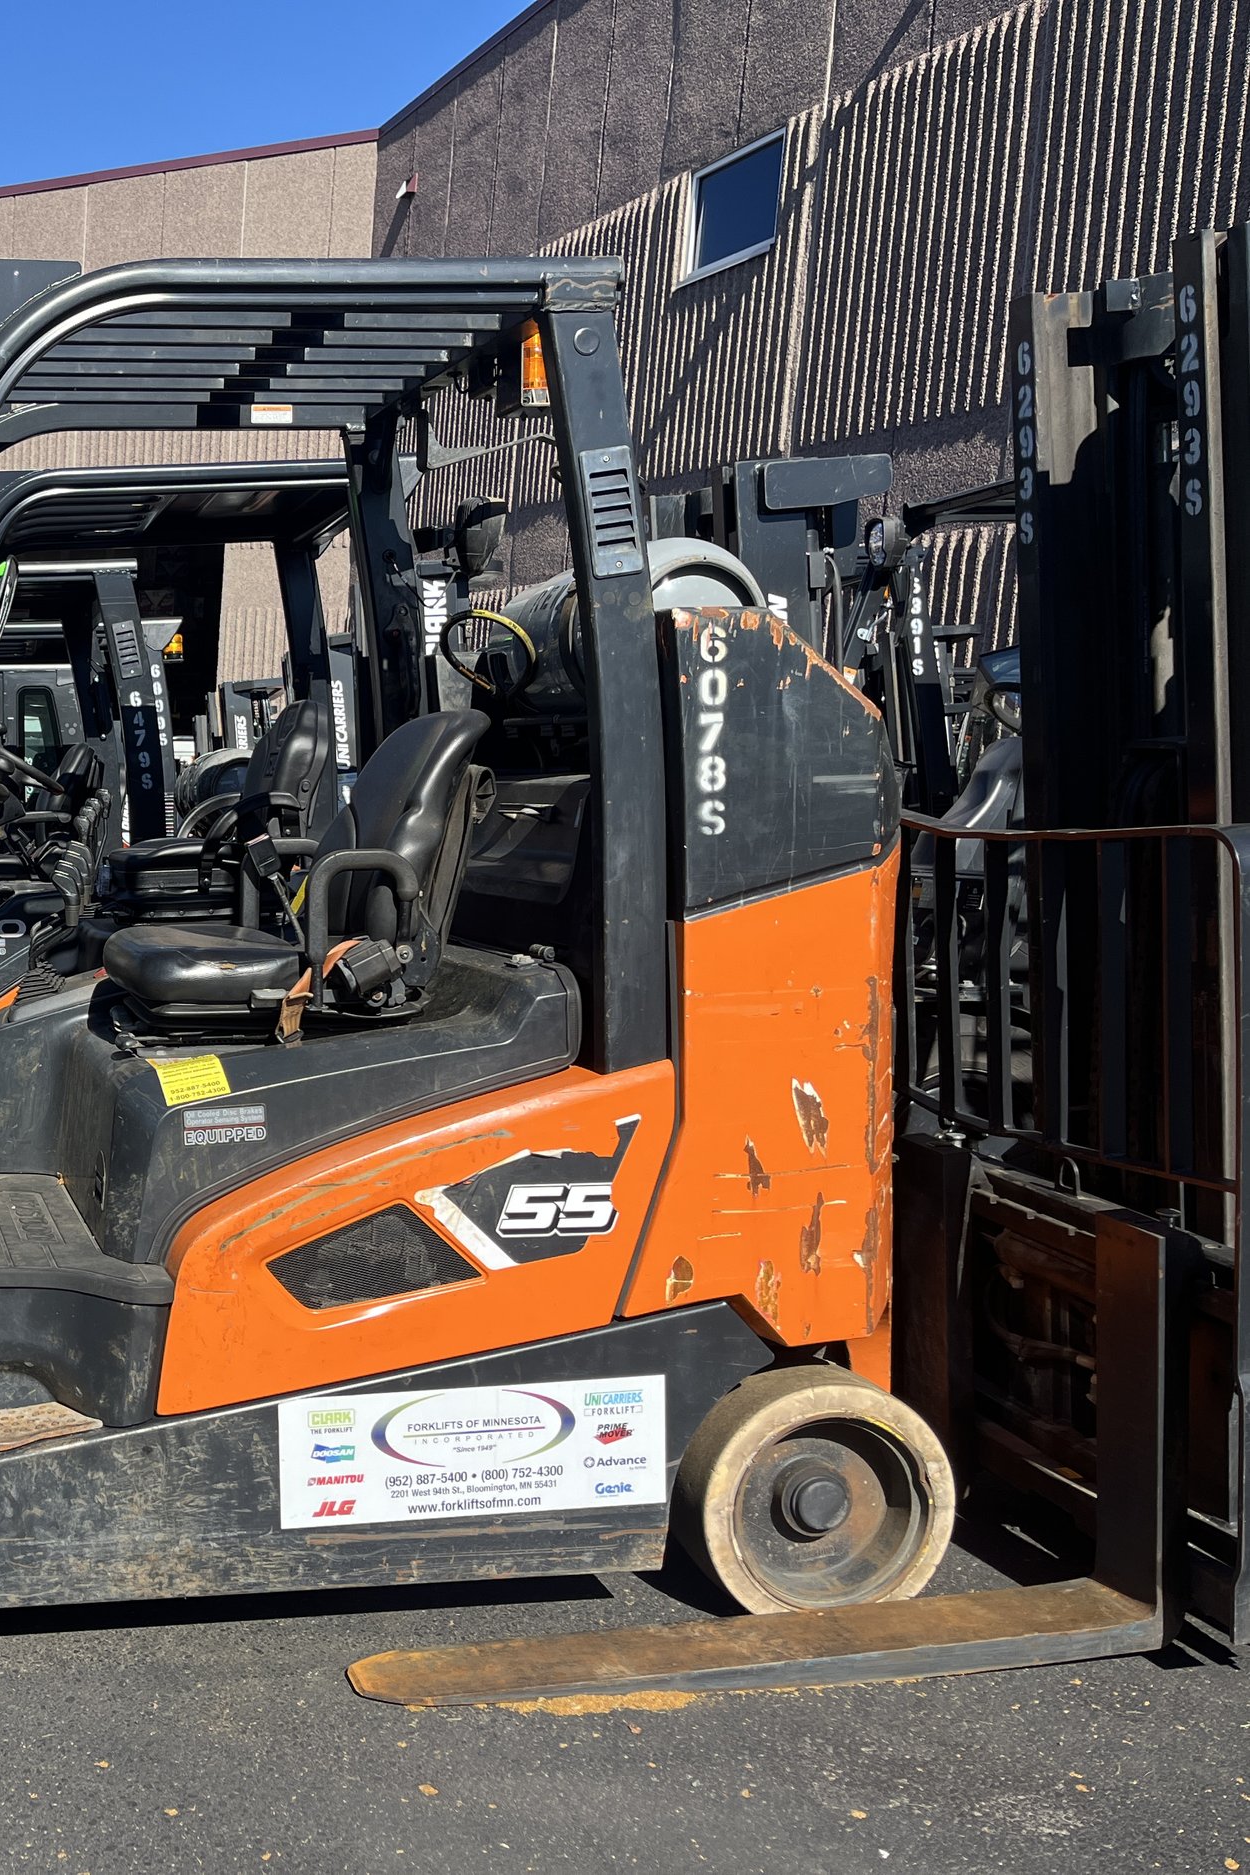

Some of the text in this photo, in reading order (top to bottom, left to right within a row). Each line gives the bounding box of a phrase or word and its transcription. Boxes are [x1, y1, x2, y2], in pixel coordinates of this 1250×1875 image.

[1179, 284, 1202, 516] 6293S
[1017, 341, 1034, 545] 6293S
[700, 626, 728, 836] 6078S
[129, 691, 153, 790] 6479S
[197, 1110, 220, 1118] Cooled
[240, 1107, 263, 1115] Brakes
[186, 1117, 213, 1126] Operator
[240, 1115, 263, 1123] System
[184, 1126, 267, 1146] EQUIPPED
[496, 1182, 619, 1238] 55
[311, 1411, 352, 1426] CLARK
[591, 1406, 636, 1416] FORKLIFT
[324, 1426, 353, 1435] FORKLIFT
[407, 1416, 541, 1432] FORKLIFTS OF MINNESOTA
[597, 1422, 629, 1431] PRIME
[414, 1431, 534, 1445] INCORPORATED
[599, 1429, 634, 1438] MOVER
[313, 1447, 355, 1459] DOOSAN
[597, 1456, 647, 1467] Advance
[316, 1474, 365, 1486] MANITOU
[385, 1465, 564, 1489] (952) 887-5400 (800) 752-4300
[391, 1480, 558, 1499] 2201 West 94th St., Bloomington, MN 55431
[595, 1482, 633, 1495] Genie
[312, 1499, 356, 1518] JLG
[408, 1495, 542, 1514] www.forkliftsofmn.com
